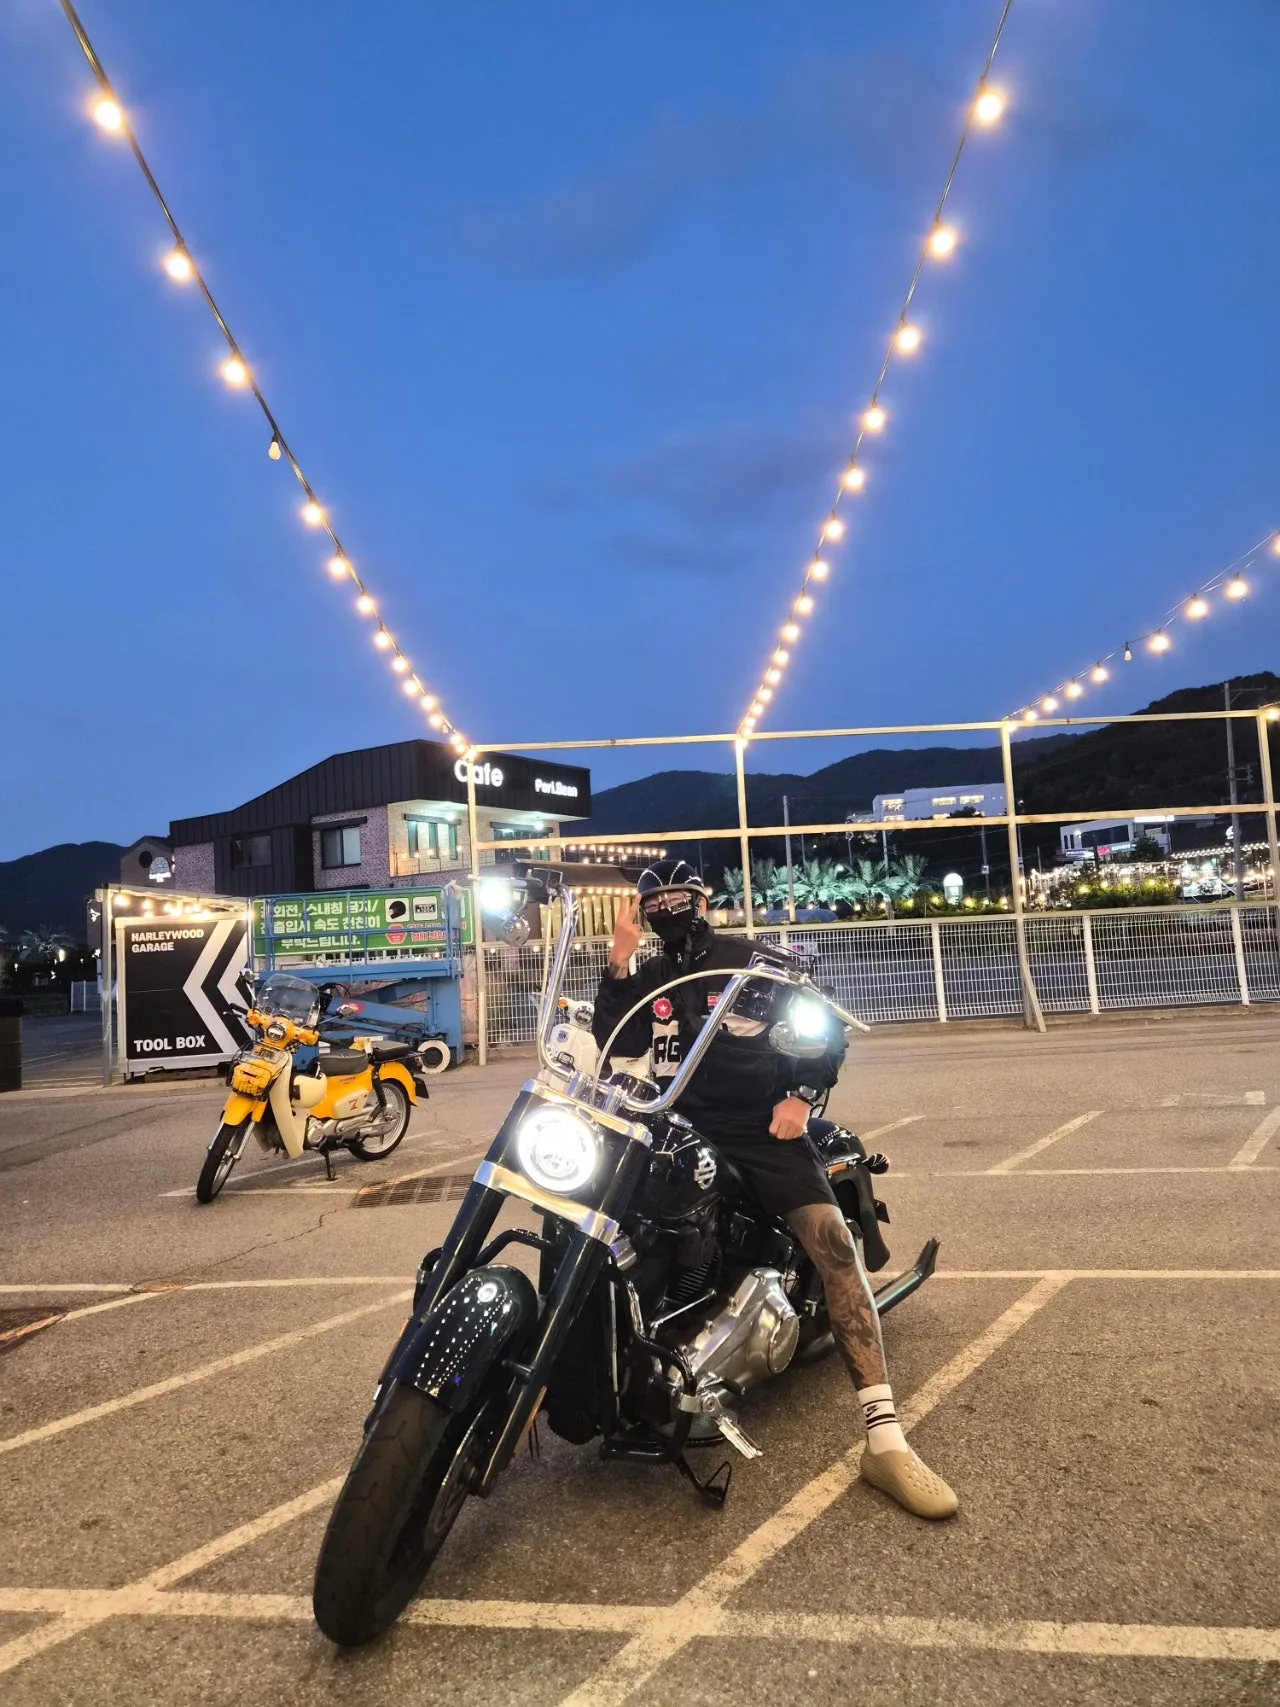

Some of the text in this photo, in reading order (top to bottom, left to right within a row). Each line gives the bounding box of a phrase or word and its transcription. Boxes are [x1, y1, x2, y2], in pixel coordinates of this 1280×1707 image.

[454, 759, 503, 787] Cafe
[305, 902, 343, 916] 스내칭
[313, 918, 339, 931] 속도
[342, 915, 381, 930] 천천히
[131, 929, 204, 942] HARLEYWOOD
[131, 942, 175, 953] GARAGE
[133, 1035, 206, 1052] TOOL BOX
